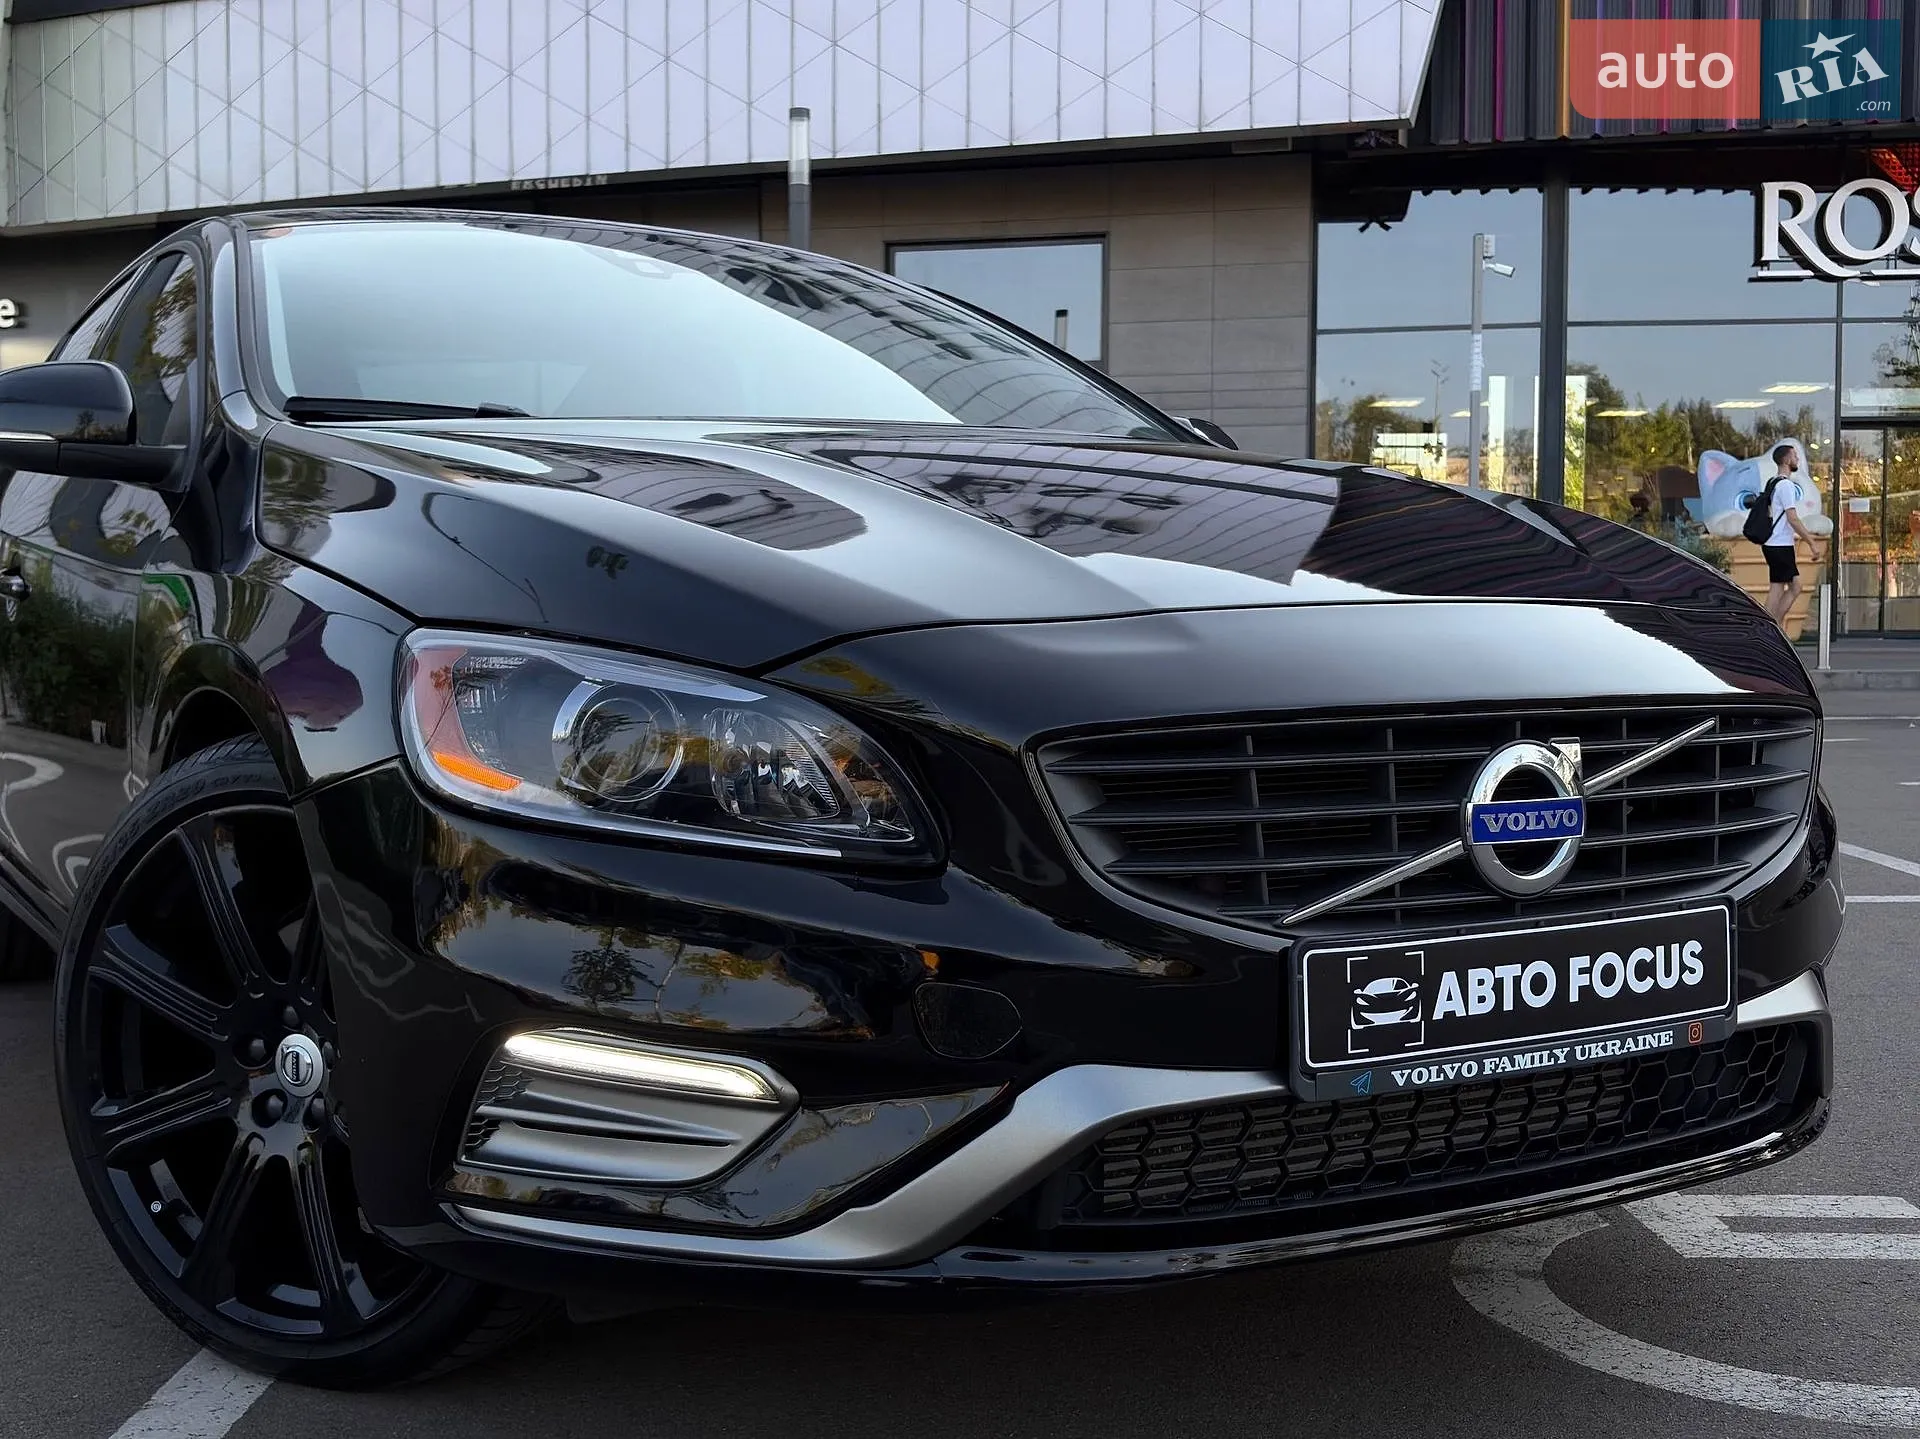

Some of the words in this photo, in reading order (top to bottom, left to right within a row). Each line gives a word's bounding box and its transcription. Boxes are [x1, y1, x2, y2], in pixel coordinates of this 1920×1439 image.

[1760, 178, 1920, 278] RO
[1479, 808, 1578, 833] VOLVO
[1569, 940, 1704, 1003] FOCUS
[1391, 1060, 1479, 1087] VOLVO
[1482, 1048, 1571, 1075] FAMILY
[1575, 1030, 1674, 1061] UKRAINE
